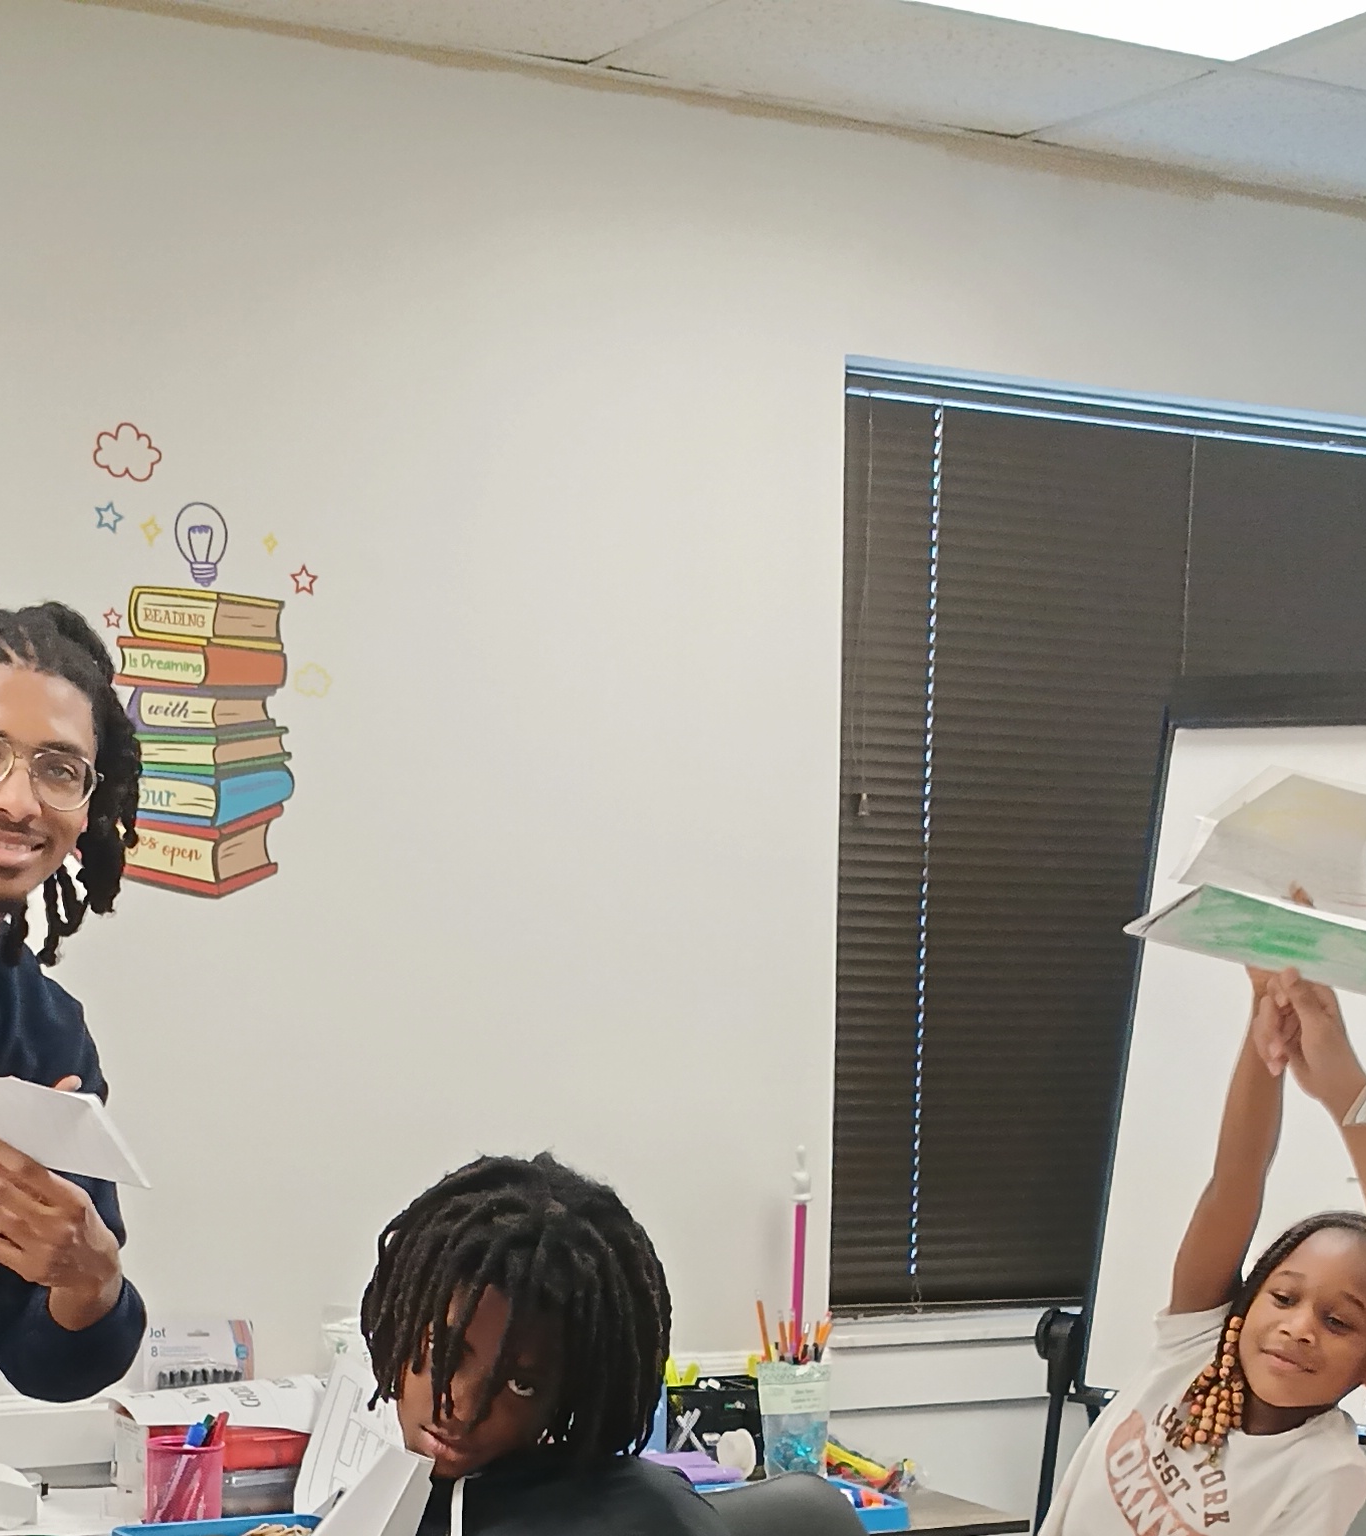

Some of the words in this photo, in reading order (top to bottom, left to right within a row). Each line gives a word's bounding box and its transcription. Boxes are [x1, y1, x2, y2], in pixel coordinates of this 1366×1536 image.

[142, 606, 206, 628] READING
[129, 653, 139, 670] Is
[141, 656, 202, 678] Dreaming
[148, 701, 189, 719] with
[162, 845, 201, 867] open
[149, 1327, 166, 1339] Jot
[151, 1346, 158, 1357] 8
